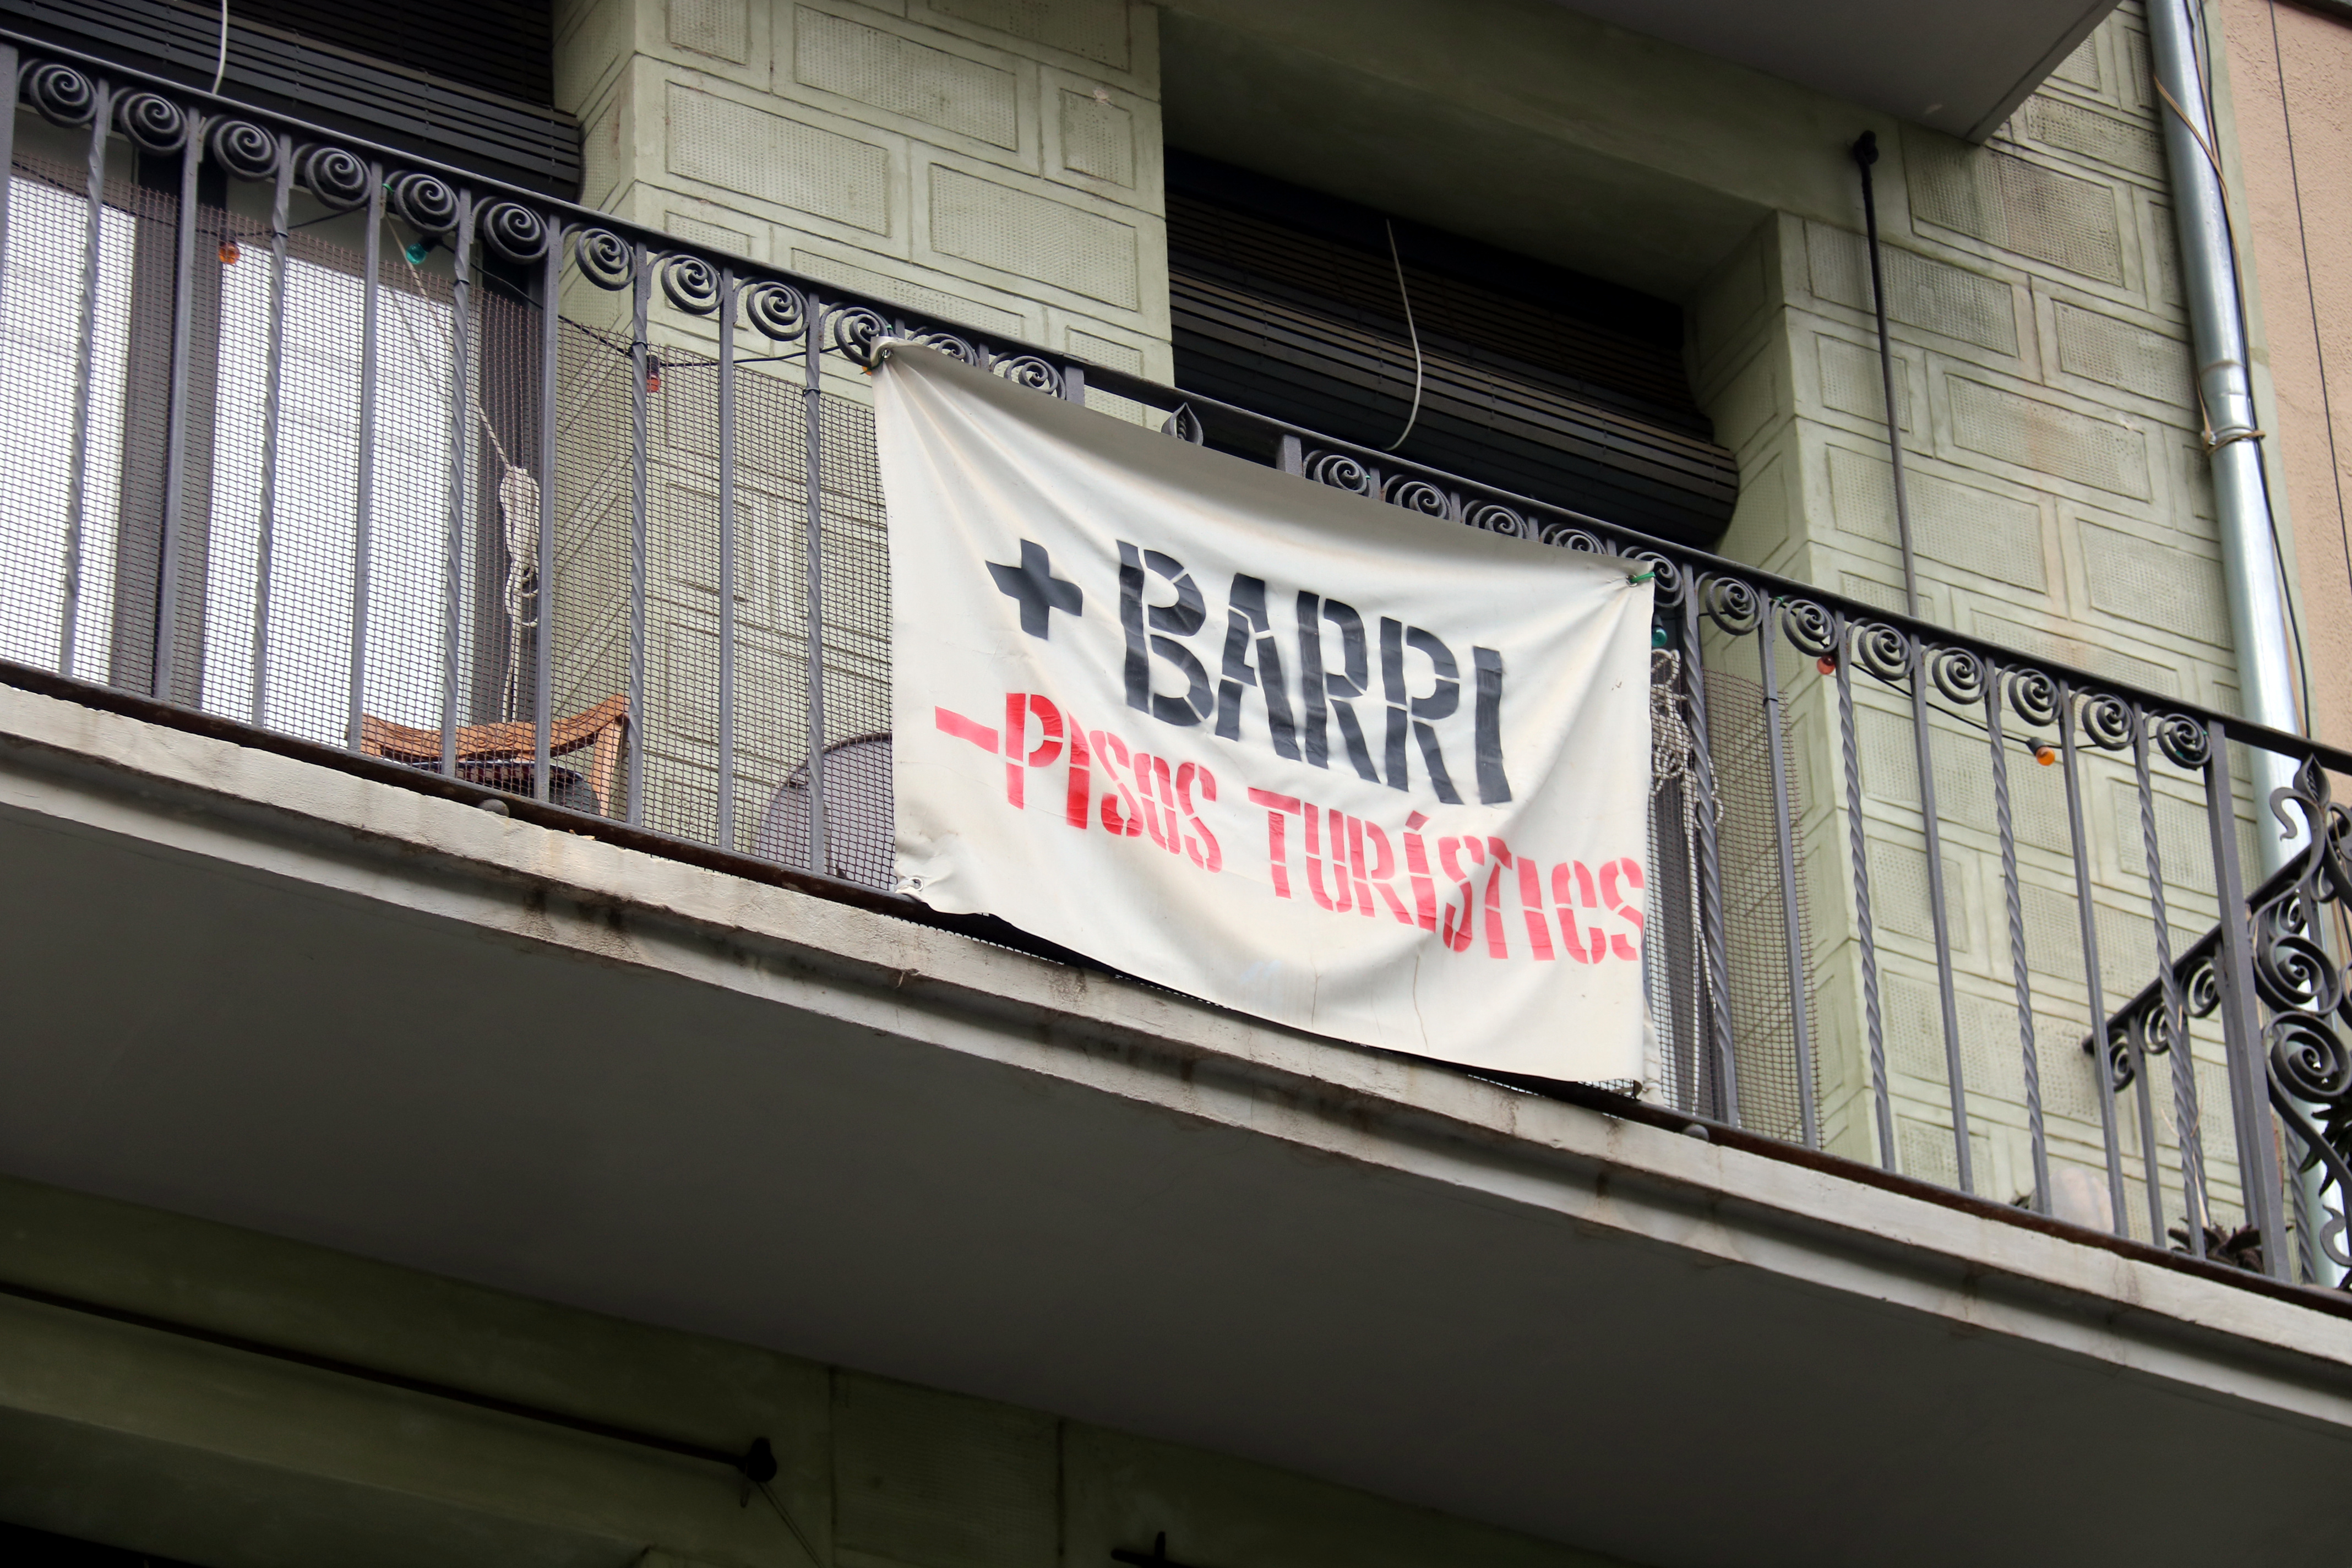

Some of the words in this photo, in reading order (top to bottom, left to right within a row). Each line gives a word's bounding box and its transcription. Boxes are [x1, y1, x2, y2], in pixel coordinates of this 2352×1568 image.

[1115, 540, 1512, 804] BARRI
[1005, 692, 1223, 873] PISOS
[1247, 787, 1645, 965] TURÍSTICS
